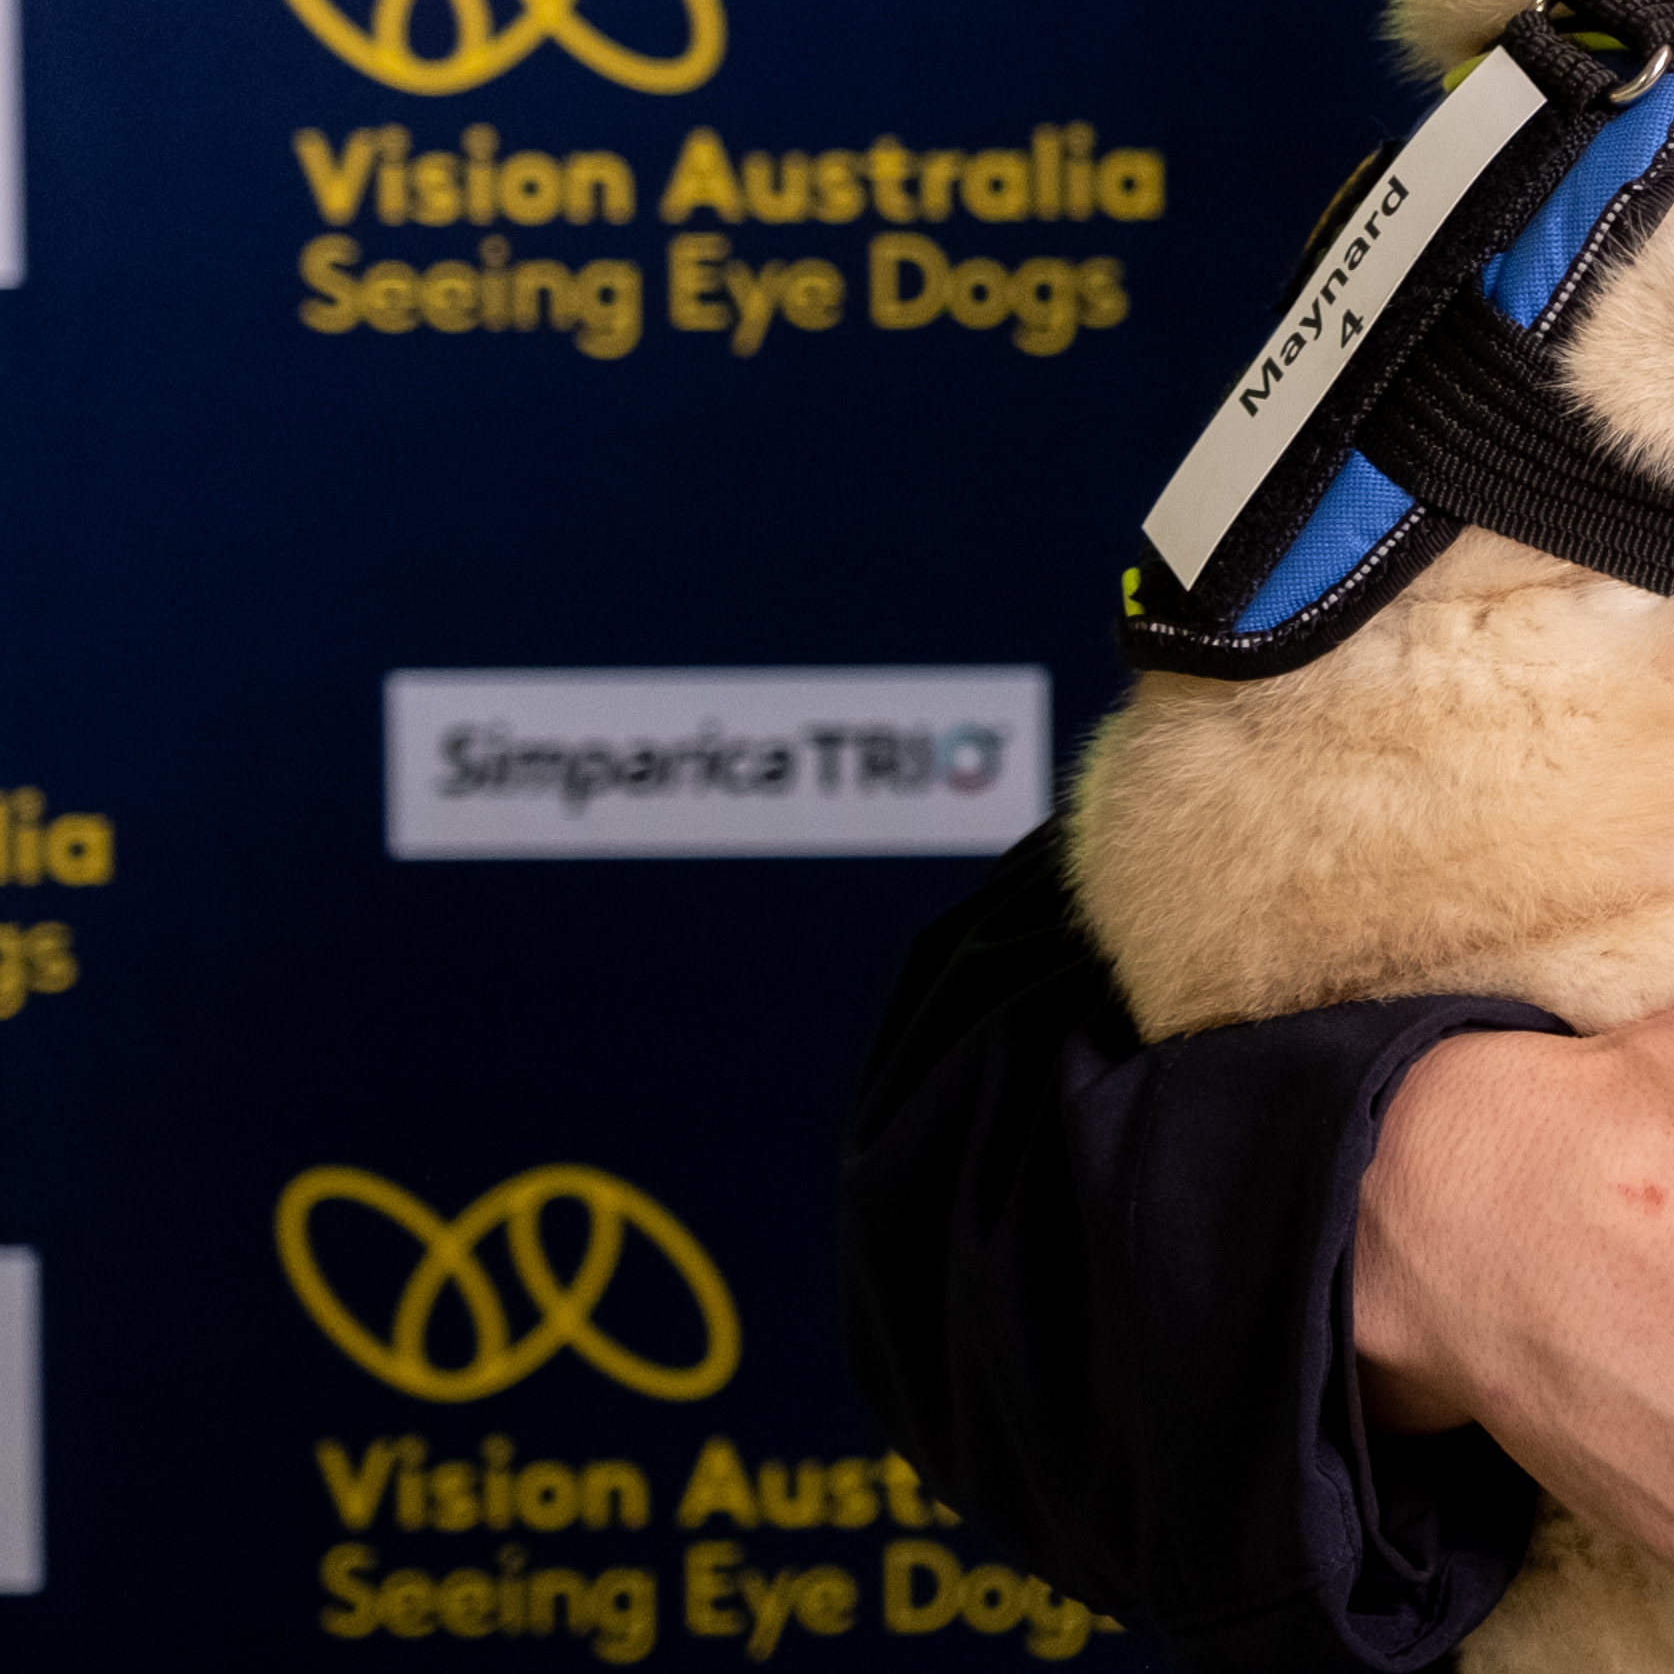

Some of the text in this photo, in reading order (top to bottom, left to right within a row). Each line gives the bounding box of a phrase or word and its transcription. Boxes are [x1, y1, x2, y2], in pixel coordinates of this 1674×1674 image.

[296, 124, 1165, 227] Vision Australia
[300, 232, 1129, 359] Seeing Eye Dogs
[1239, 174, 1409, 417] Maynard
[1341, 308, 1364, 348] 4
[317, 1435, 962, 1532] Vision Aust
[321, 1539, 1124, 1663] Seeing Eye Dog
